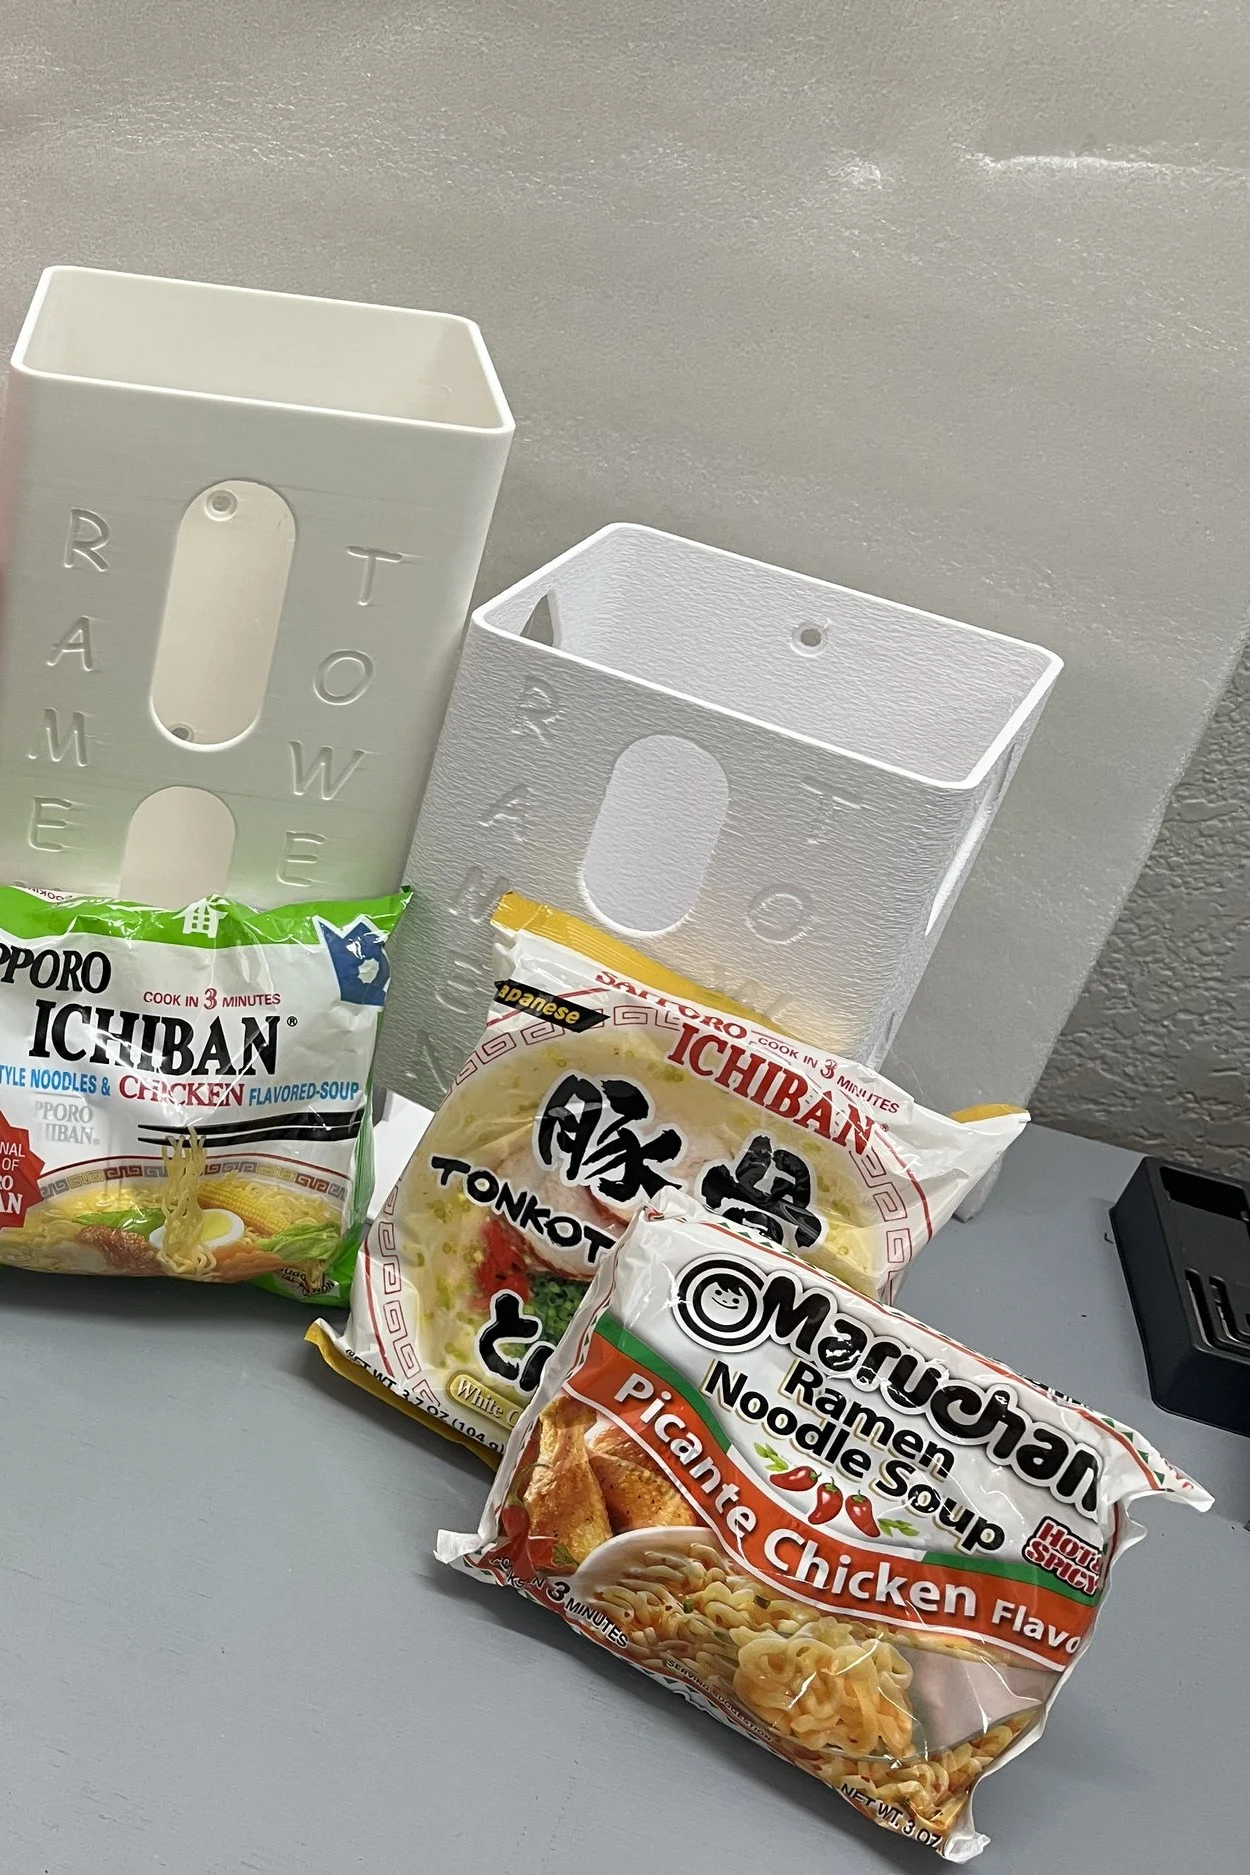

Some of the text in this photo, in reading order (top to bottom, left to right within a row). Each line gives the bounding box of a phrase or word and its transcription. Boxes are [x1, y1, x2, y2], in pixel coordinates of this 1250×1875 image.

[27, 507, 110, 852] RAME
[143, 987, 281, 1010] COOK IN 3 MINUTES
[498, 984, 581, 1024] apanese
[28, 999, 281, 1076] ICHIBAN
[30, 1068, 97, 1095] NOODLES
[101, 1076, 111, 1097] &
[119, 1075, 245, 1107] CHICKEN
[249, 1081, 359, 1106] FLAVORED-SOUP
[668, 1021, 875, 1156] ICHIBAN
[758, 1037, 900, 1114] COOK IN 3 MINUTES
[1, 1157, 20, 1171] OF
[427, 1405, 450, 1424] OZ
[452, 1417, 486, 1443] (104
[456, 1377, 504, 1419] White
[763, 1274, 1100, 1513] Maruchan
[784, 1360, 956, 1480] Ramen
[705, 1360, 1006, 1552] Noodle Soup
[614, 1373, 757, 1537] Picante
[764, 1528, 976, 1617] Chicken
[1026, 1539, 1098, 1595] SPICY
[547, 1581, 570, 1602] 3
[565, 1597, 628, 1648] MINUTES
[841, 1783, 876, 1806] NET
[903, 1820, 915, 1834] 3
